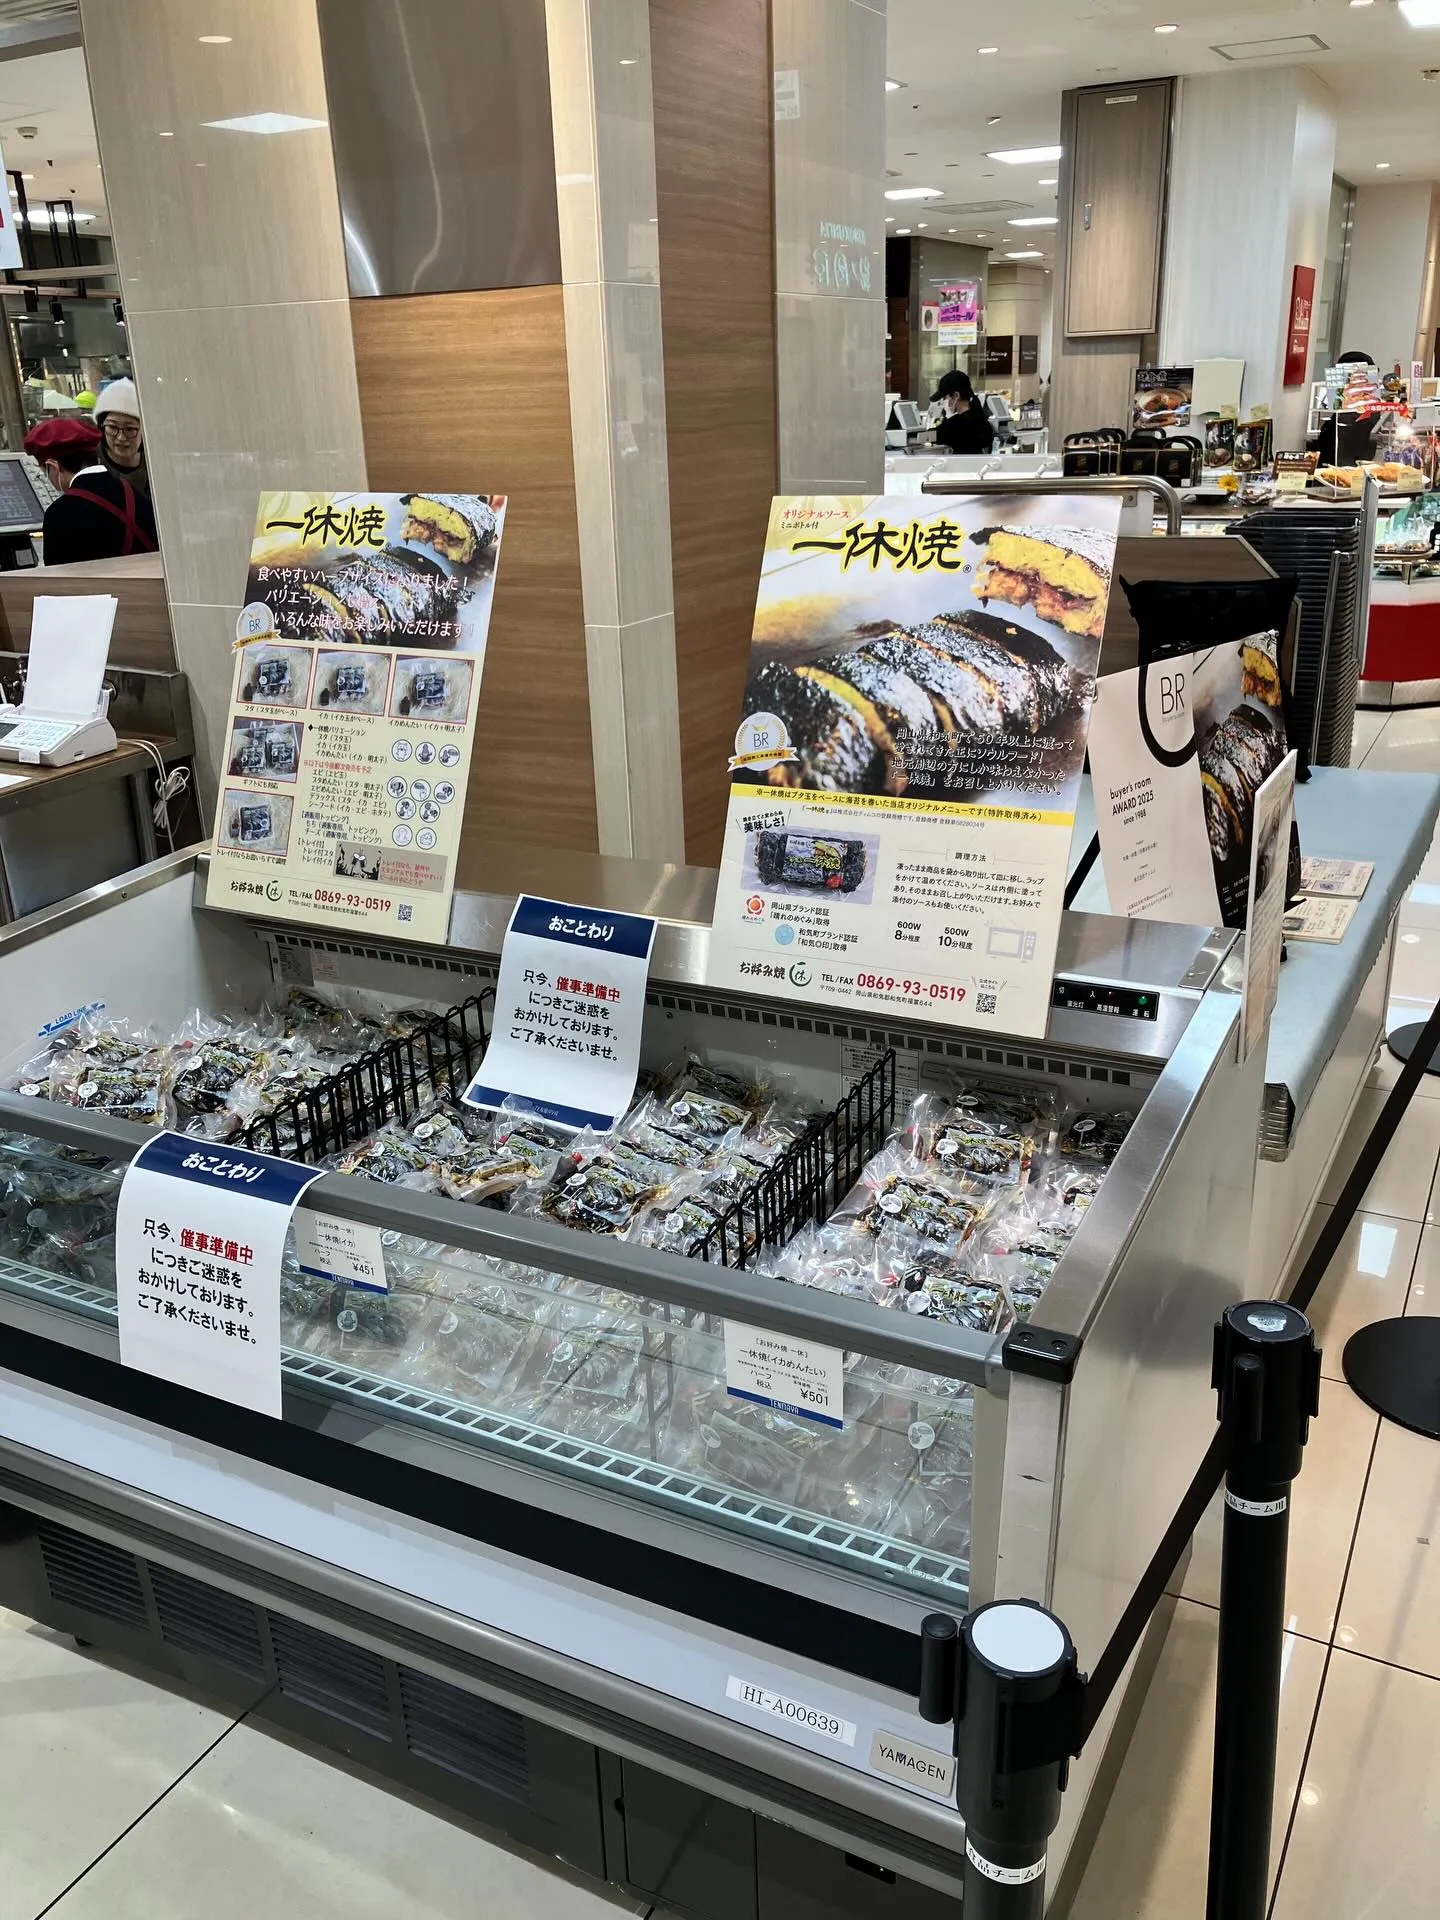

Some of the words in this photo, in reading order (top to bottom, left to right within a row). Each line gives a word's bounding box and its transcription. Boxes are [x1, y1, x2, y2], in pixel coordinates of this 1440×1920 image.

[266, 505, 386, 546] 一休焼
[780, 521, 819, 530] ミニボトル付
[783, 509, 850, 520] オリジナルソース
[792, 520, 962, 570] 一休焼
[248, 618, 262, 632] BR
[1160, 673, 1185, 715] BR
[753, 731, 770, 748] BR
[1110, 782, 1134, 801] buyer's
[1134, 776, 1152, 791] room
[1112, 797, 1137, 816] AWARD
[1137, 789, 1155, 806] 2025
[1123, 816, 1135, 826] since
[954, 851, 987, 863] 調理方法
[230, 881, 264, 897] お好み焼
[893, 885, 1041, 909] あり、そのままお召し上がりいただけます。お好みで
[895, 873, 1043, 897] をかけて温めてください。ソースは内側に塗って
[314, 889, 391, 913] 0869-93-0519
[771, 901, 830, 917] 岡山県ブランド認証
[891, 895, 985, 914] 添付のソースもお使いください。
[548, 915, 616, 942] おことわり
[770, 911, 830, 927] 「晴れのめぐみ」取得
[897, 920, 922, 931] 600W
[798, 927, 859, 943] 和気町ブランド認証
[894, 929, 921, 943] 8分程度
[938, 935, 974, 951] 10分程度
[944, 926, 970, 937] 500W
[739, 961, 786, 979] お好み焼
[522, 968, 621, 1002] 只今、催事準備中
[856, 972, 967, 1003] 0869-93-0519
[528, 990, 611, 1020] につきご迷惑を
[55, 1012, 73, 1025] LOAD
[513, 1007, 619, 1042] おかけしております。
[509, 1026, 619, 1062] ご了承くださいませ。
[181, 1151, 266, 1183] おことわり
[142, 1217, 254, 1265] 只今、催事準備中
[150, 1246, 243, 1290] につきご迷惑を
[351, 1262, 376, 1277] ¥451
[137, 1267, 255, 1318] おかけしております。
[137, 1292, 257, 1345] ご了承くださいませ。
[750, 1368, 772, 1380] ハーフ
[799, 1387, 830, 1407] ¥501
[742, 1685, 840, 1736] HI-A00639
[878, 1743, 946, 1782] YAMAGEN
